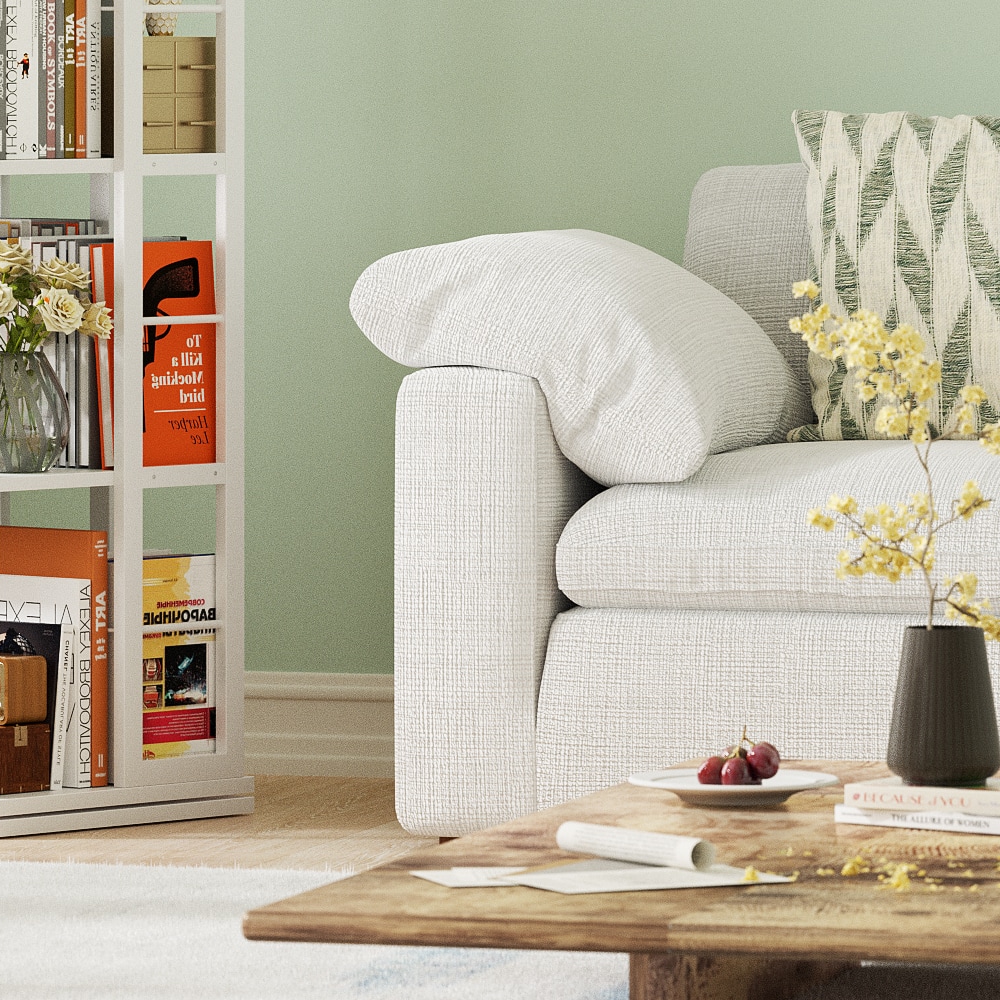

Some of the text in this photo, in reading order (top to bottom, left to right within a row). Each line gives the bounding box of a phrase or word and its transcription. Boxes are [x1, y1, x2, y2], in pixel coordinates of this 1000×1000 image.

[47, 2, 56, 43] BOOK
[47, 59, 55, 131] SYMBOLS
[892, 813, 990, 828] THE ALLURE OF WOMEN
